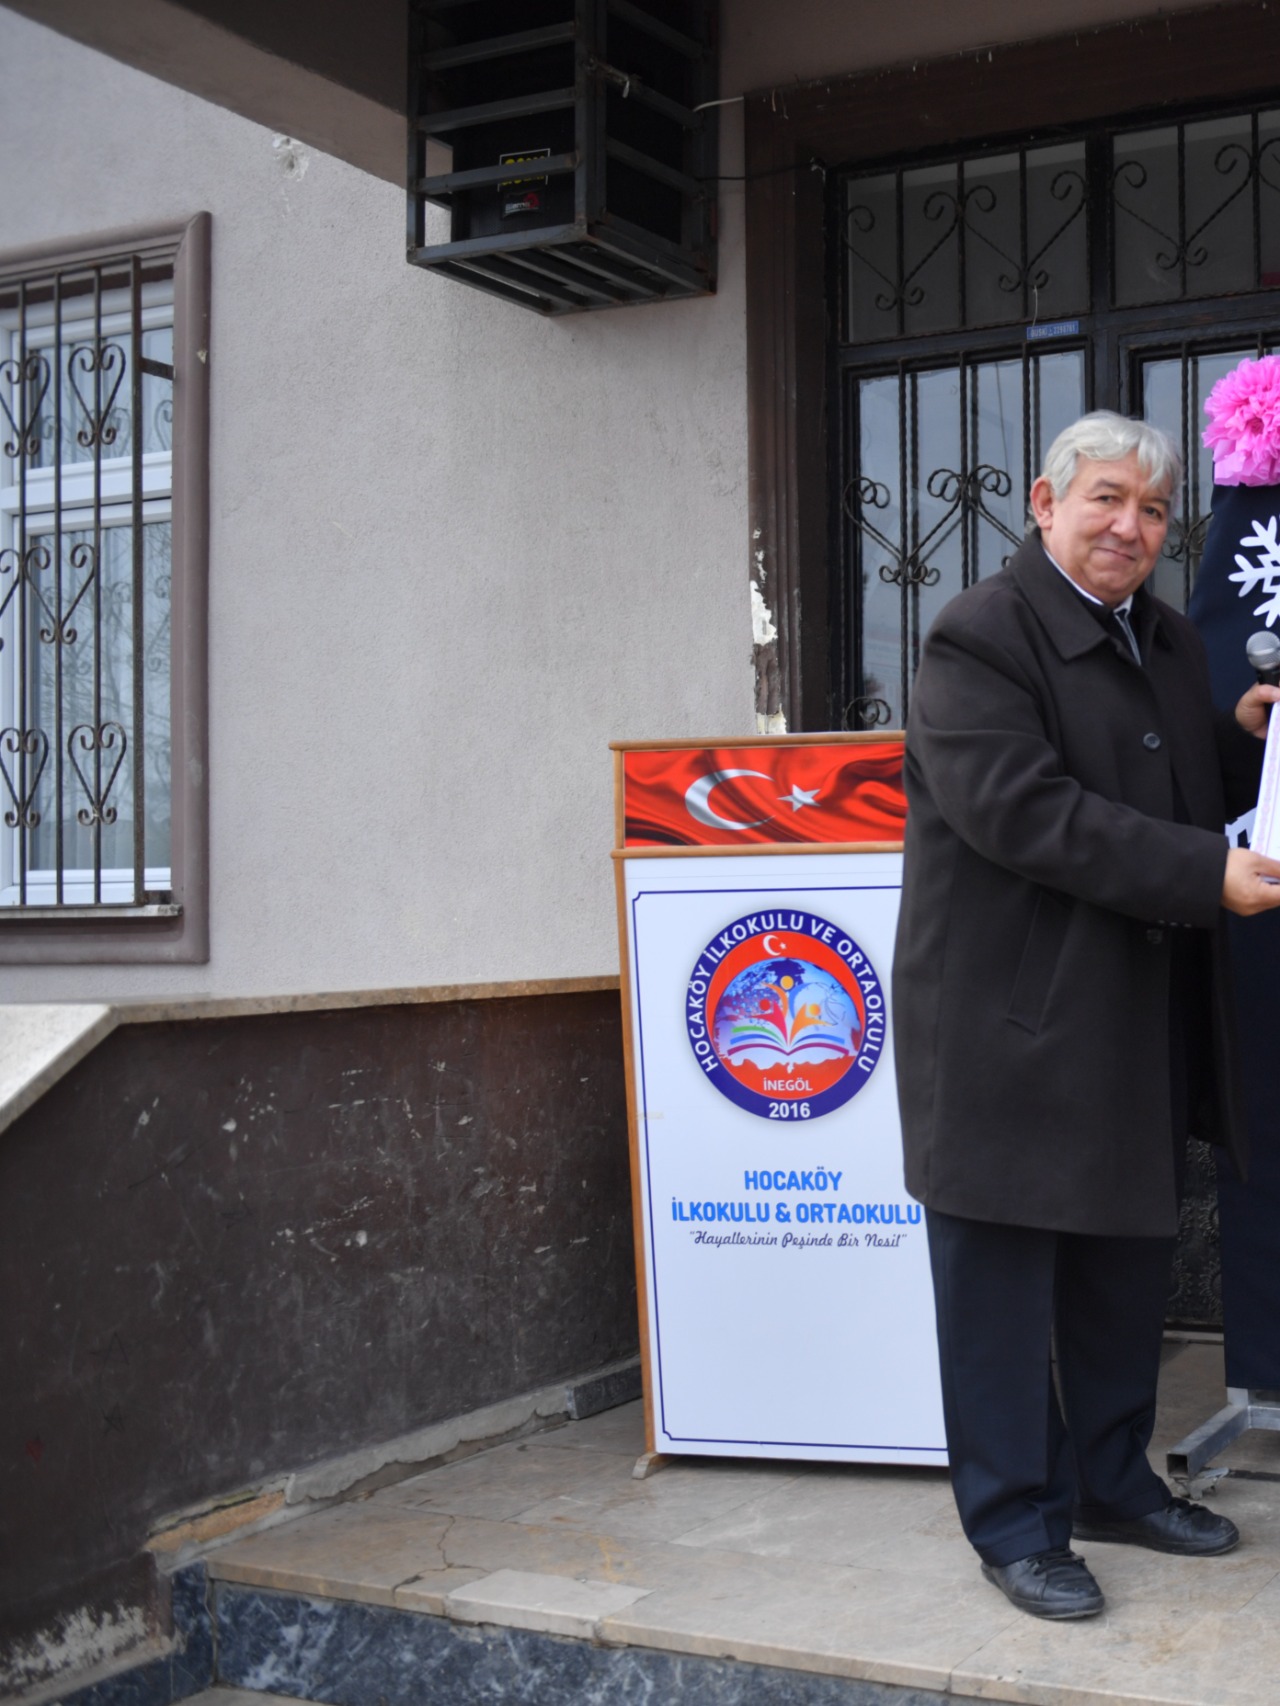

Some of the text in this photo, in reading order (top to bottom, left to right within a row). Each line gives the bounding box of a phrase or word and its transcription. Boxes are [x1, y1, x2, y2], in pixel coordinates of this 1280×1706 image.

[688, 913, 884, 1073] HOCAKÖY İLKOKULU VE ORTAOKULU
[763, 1077, 814, 1091] İNEGÖL
[768, 1102, 811, 1118] 2016
[744, 1166, 843, 1191] HOCAKÖY
[671, 1197, 922, 1225] İLKOKULU & ORTAOKULU
[781, 1232, 833, 1250] Peşinde
[837, 1233, 860, 1247] Bir
